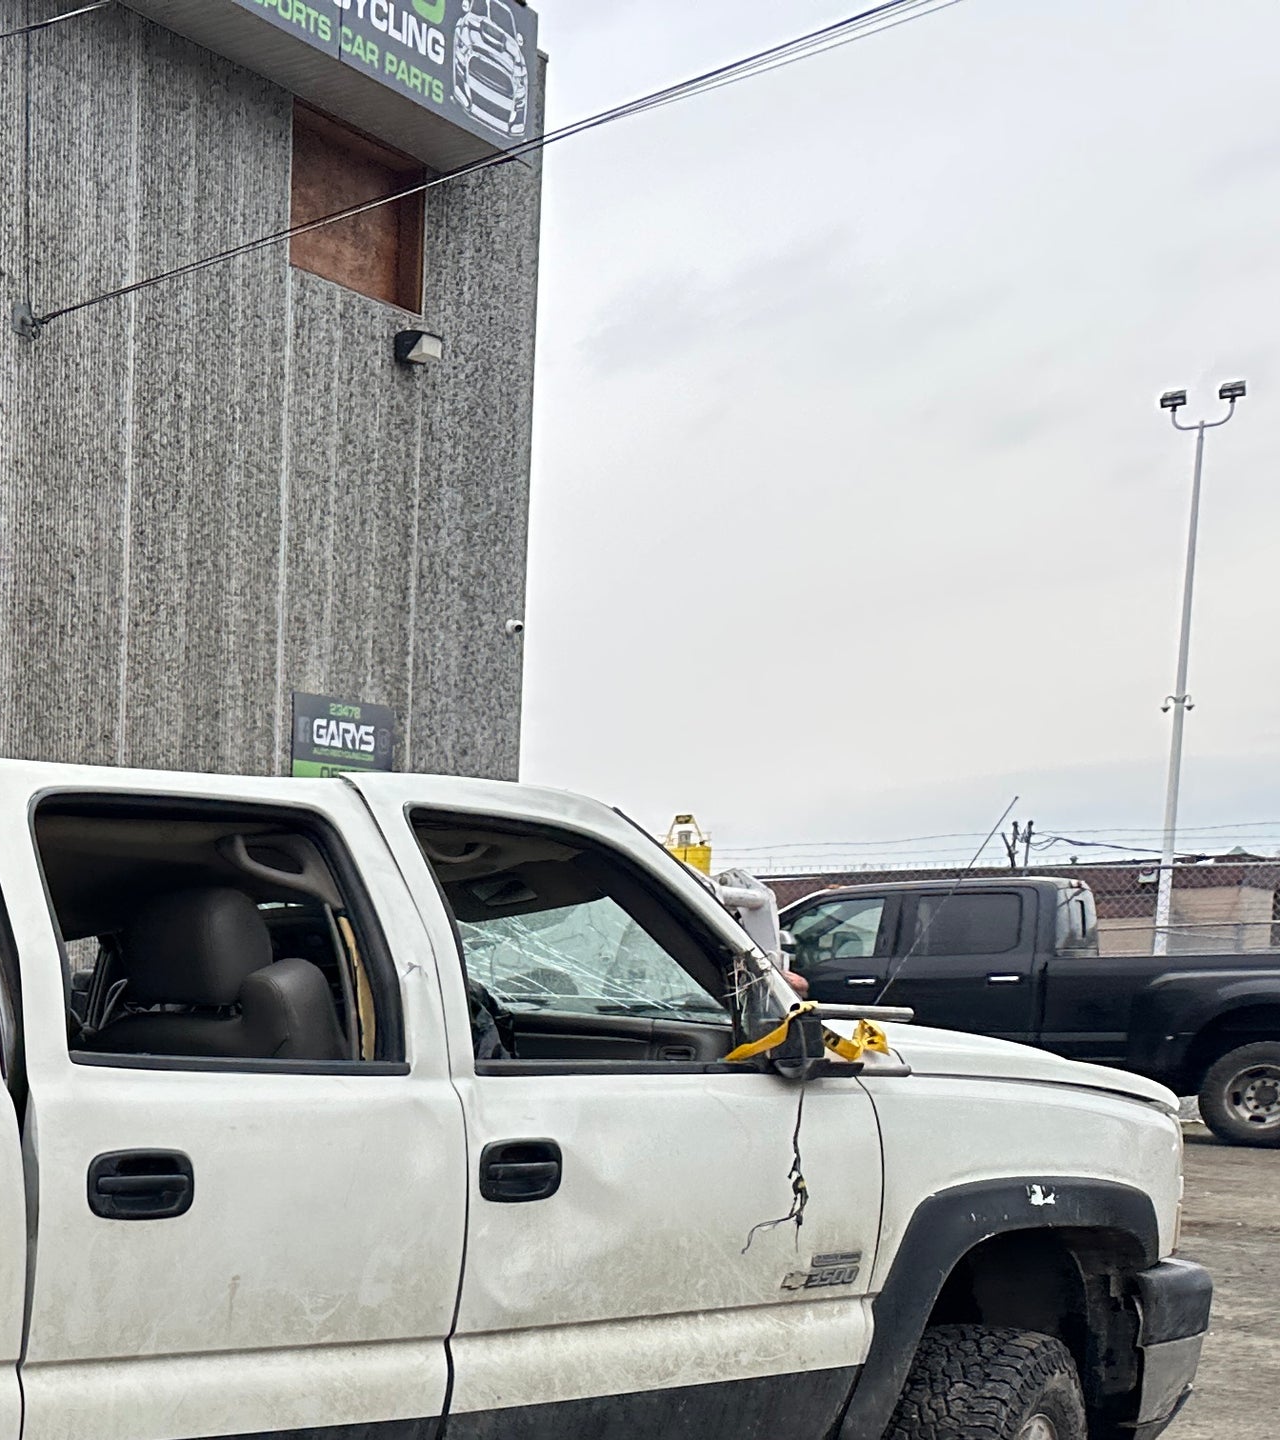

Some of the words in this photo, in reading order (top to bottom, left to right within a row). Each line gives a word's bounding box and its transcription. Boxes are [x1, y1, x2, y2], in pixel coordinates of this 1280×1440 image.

[341, 26, 379, 69] CAR
[384, 53, 444, 104] PARTS
[312, 718, 375, 753] GARYS
